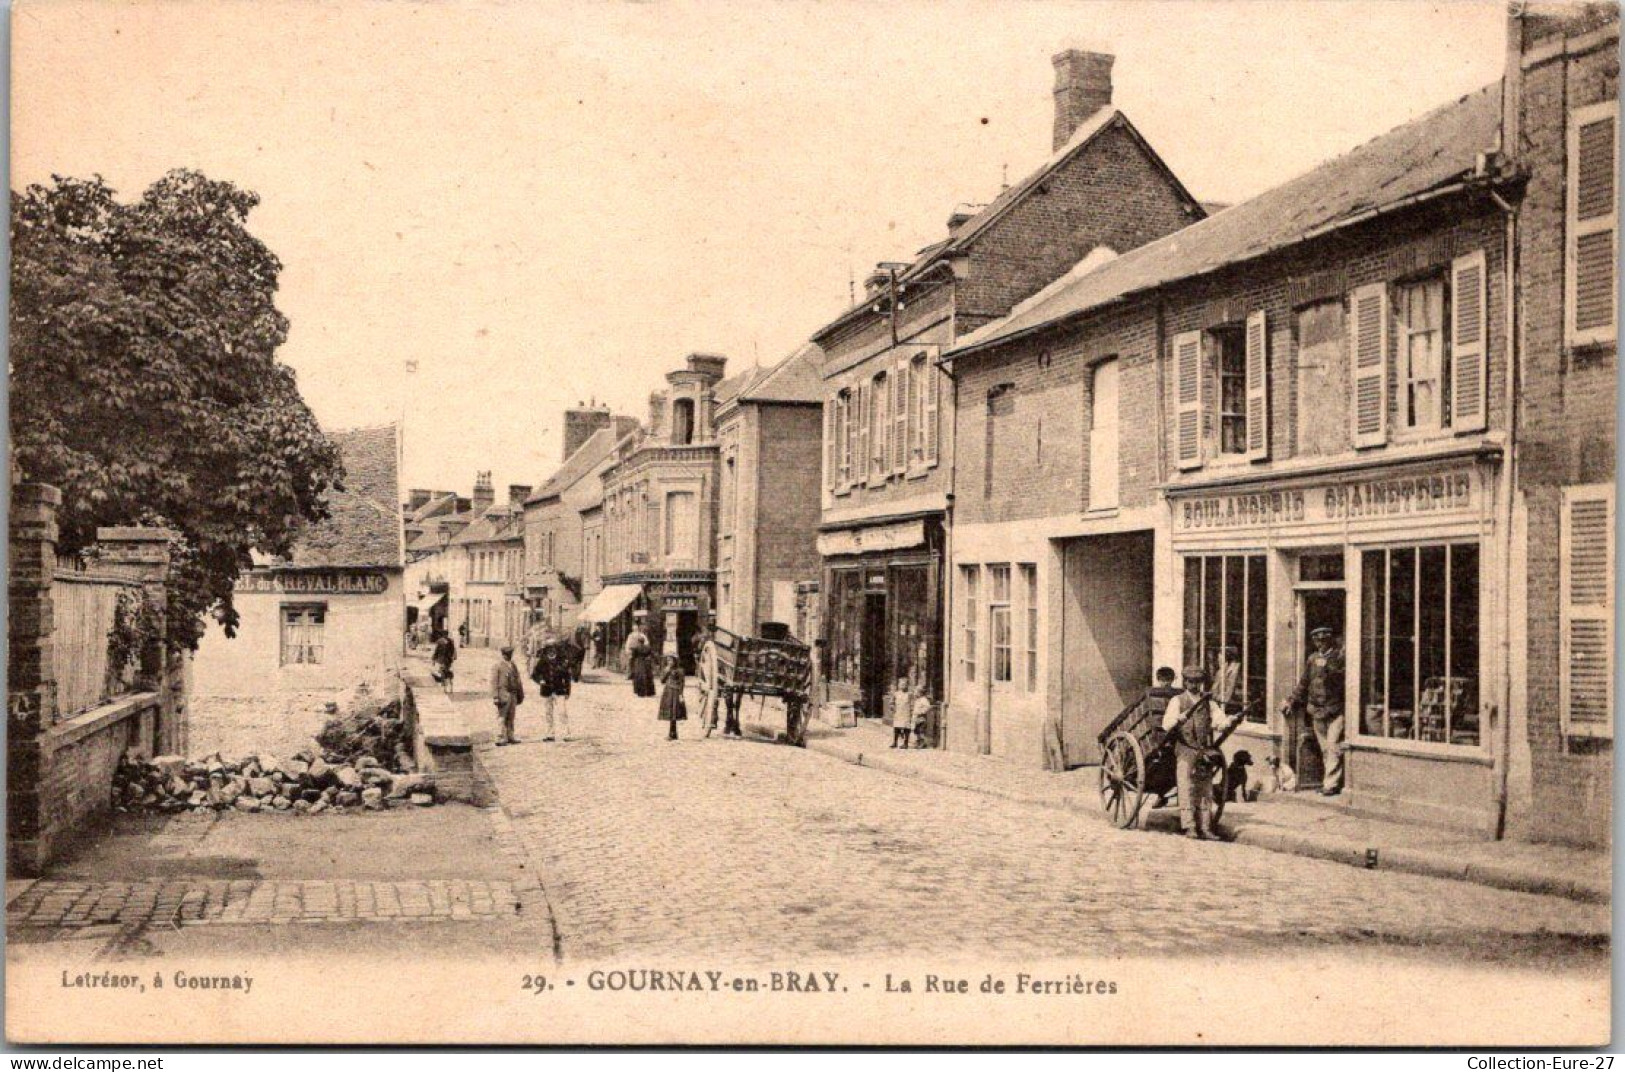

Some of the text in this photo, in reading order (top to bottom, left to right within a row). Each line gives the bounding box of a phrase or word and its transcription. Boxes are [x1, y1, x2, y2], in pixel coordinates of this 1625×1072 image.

[1183, 473, 1470, 528] BOULANGERIE GRAINETERIE
[258, 579, 270, 590] du
